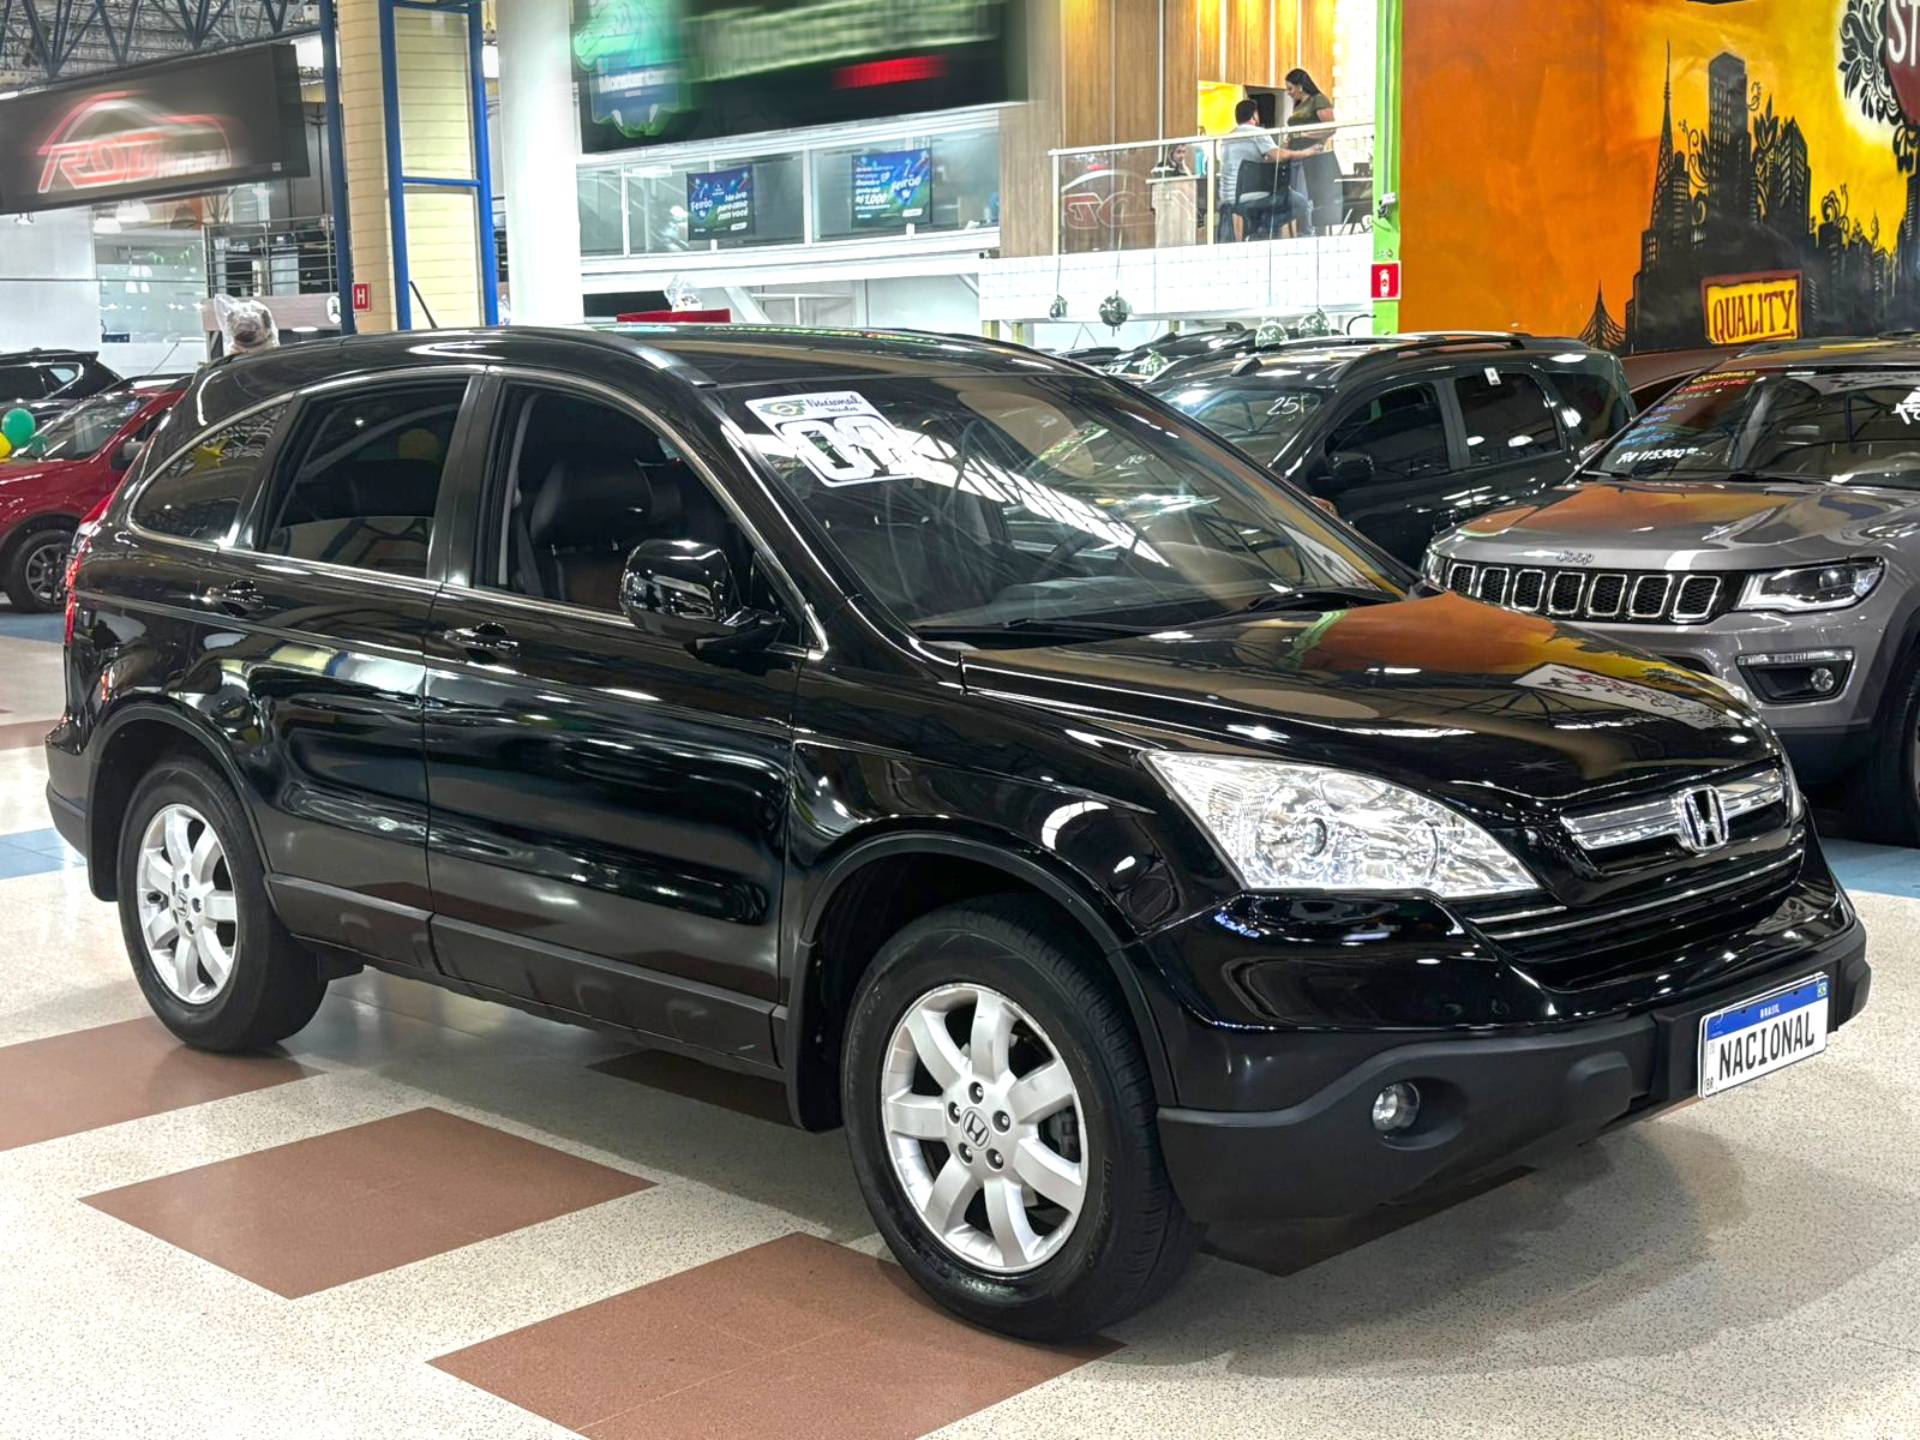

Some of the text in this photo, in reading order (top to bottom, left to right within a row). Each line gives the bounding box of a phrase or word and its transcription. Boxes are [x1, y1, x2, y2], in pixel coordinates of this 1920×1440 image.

[356, 287, 366, 305] H
[1713, 288, 1795, 343] QUALITY
[1556, 550, 1595, 566] Jeep
[1760, 1003, 1780, 1019] BRASIL
[1719, 1011, 1815, 1081] NACIONAL
